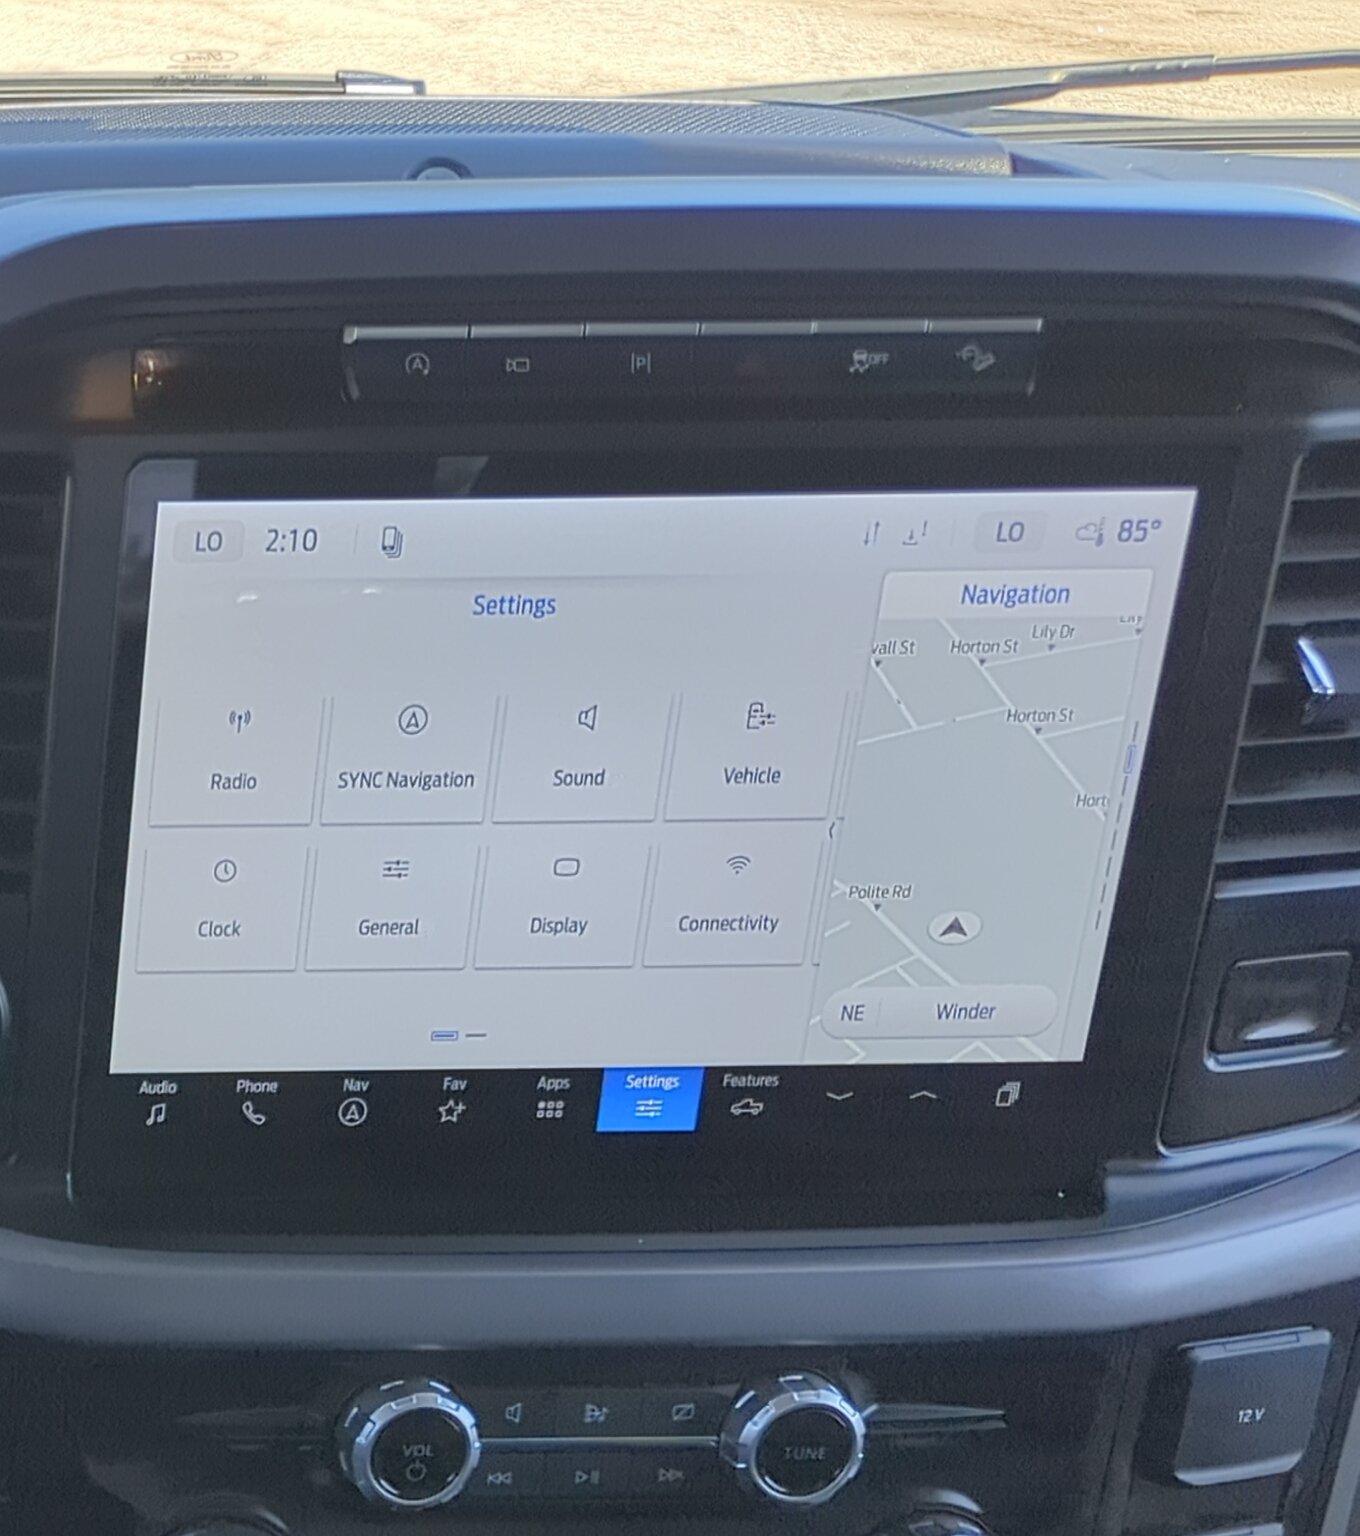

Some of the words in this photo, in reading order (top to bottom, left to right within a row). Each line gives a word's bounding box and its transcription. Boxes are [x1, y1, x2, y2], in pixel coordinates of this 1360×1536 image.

[994, 521, 1025, 544] LO
[1116, 518, 1163, 544] 85°
[194, 530, 224, 553] LO
[264, 528, 319, 554] 2:10
[960, 584, 1071, 608] Navigation
[472, 594, 557, 619] Settings
[1031, 624, 1057, 642] Lily
[1059, 625, 1076, 639] Dr
[900, 640, 916, 655] St
[950, 640, 1000, 654] Horton
[1002, 639, 1018, 654] St
[1006, 709, 1055, 723] Horton
[1057, 708, 1074, 723] St
[209, 772, 257, 791] Radio
[337, 770, 382, 790] SYNC
[386, 770, 475, 792] Navigation
[552, 769, 605, 788] Sound
[723, 767, 781, 785] Vehicle
[1075, 795, 1110, 808] Hort
[848, 884, 890, 900] Polite
[892, 884, 912, 899] Rd
[197, 919, 241, 938] Clock
[358, 918, 419, 937] General
[530, 916, 588, 937] Display
[678, 914, 780, 934] Connectivity
[840, 1004, 865, 1022] NE
[936, 1003, 996, 1022] Winder
[139, 1080, 177, 1095] Audio
[236, 1079, 278, 1094] Phone
[343, 1078, 370, 1093] Nav
[442, 1077, 467, 1092] Fav
[537, 1076, 570, 1094] Apps
[624, 1073, 680, 1092] Settings
[722, 1073, 779, 1088] Features
[1237, 1410, 1253, 1424] 12
[402, 1444, 434, 1458] VOL
[784, 1447, 827, 1460] TUNE
